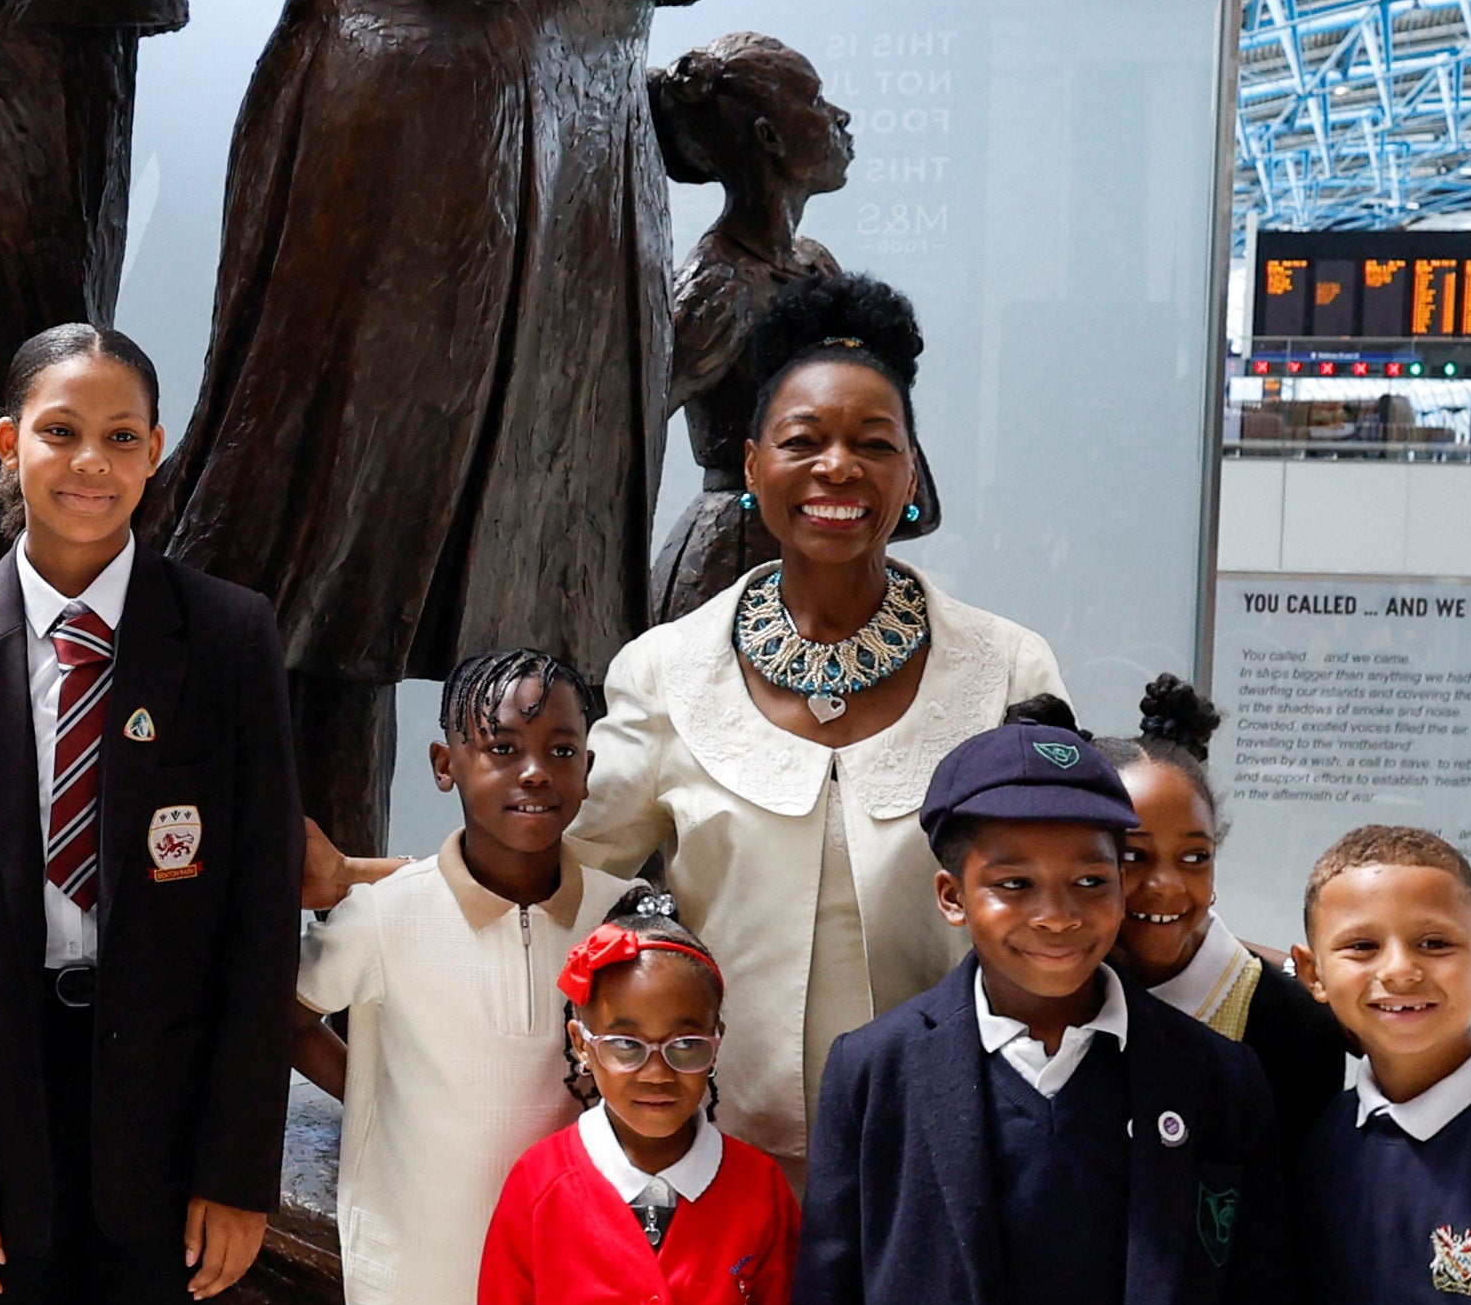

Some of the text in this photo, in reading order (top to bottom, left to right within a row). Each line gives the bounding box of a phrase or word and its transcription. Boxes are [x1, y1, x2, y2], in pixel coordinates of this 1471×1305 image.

[1244, 593, 1279, 613] YOU
[1286, 594, 1357, 615] CALLED
[1385, 597, 1428, 616] AND
[1437, 598, 1466, 618] WE
[1242, 649, 1266, 662] You
[1324, 652, 1349, 664] and
[1352, 654, 1370, 664] we
[1240, 667, 1252, 678] In
[1293, 668, 1332, 682] bigger
[1335, 669, 1364, 681] than
[1367, 670, 1421, 684] anything
[1447, 672, 1471, 684] had
[1368, 688, 1394, 700] and
[1253, 701, 1273, 713] the
[1428, 724, 1448, 735] the
[1236, 736, 1294, 751] travelling
[1313, 738, 1335, 750] the
[1236, 753, 1277, 766] Driven
[1279, 754, 1297, 769] by
[1234, 771, 1259, 783] and
[1262, 773, 1310, 786] support
[1248, 789, 1269, 801] the
[1335, 790, 1350, 803] of
